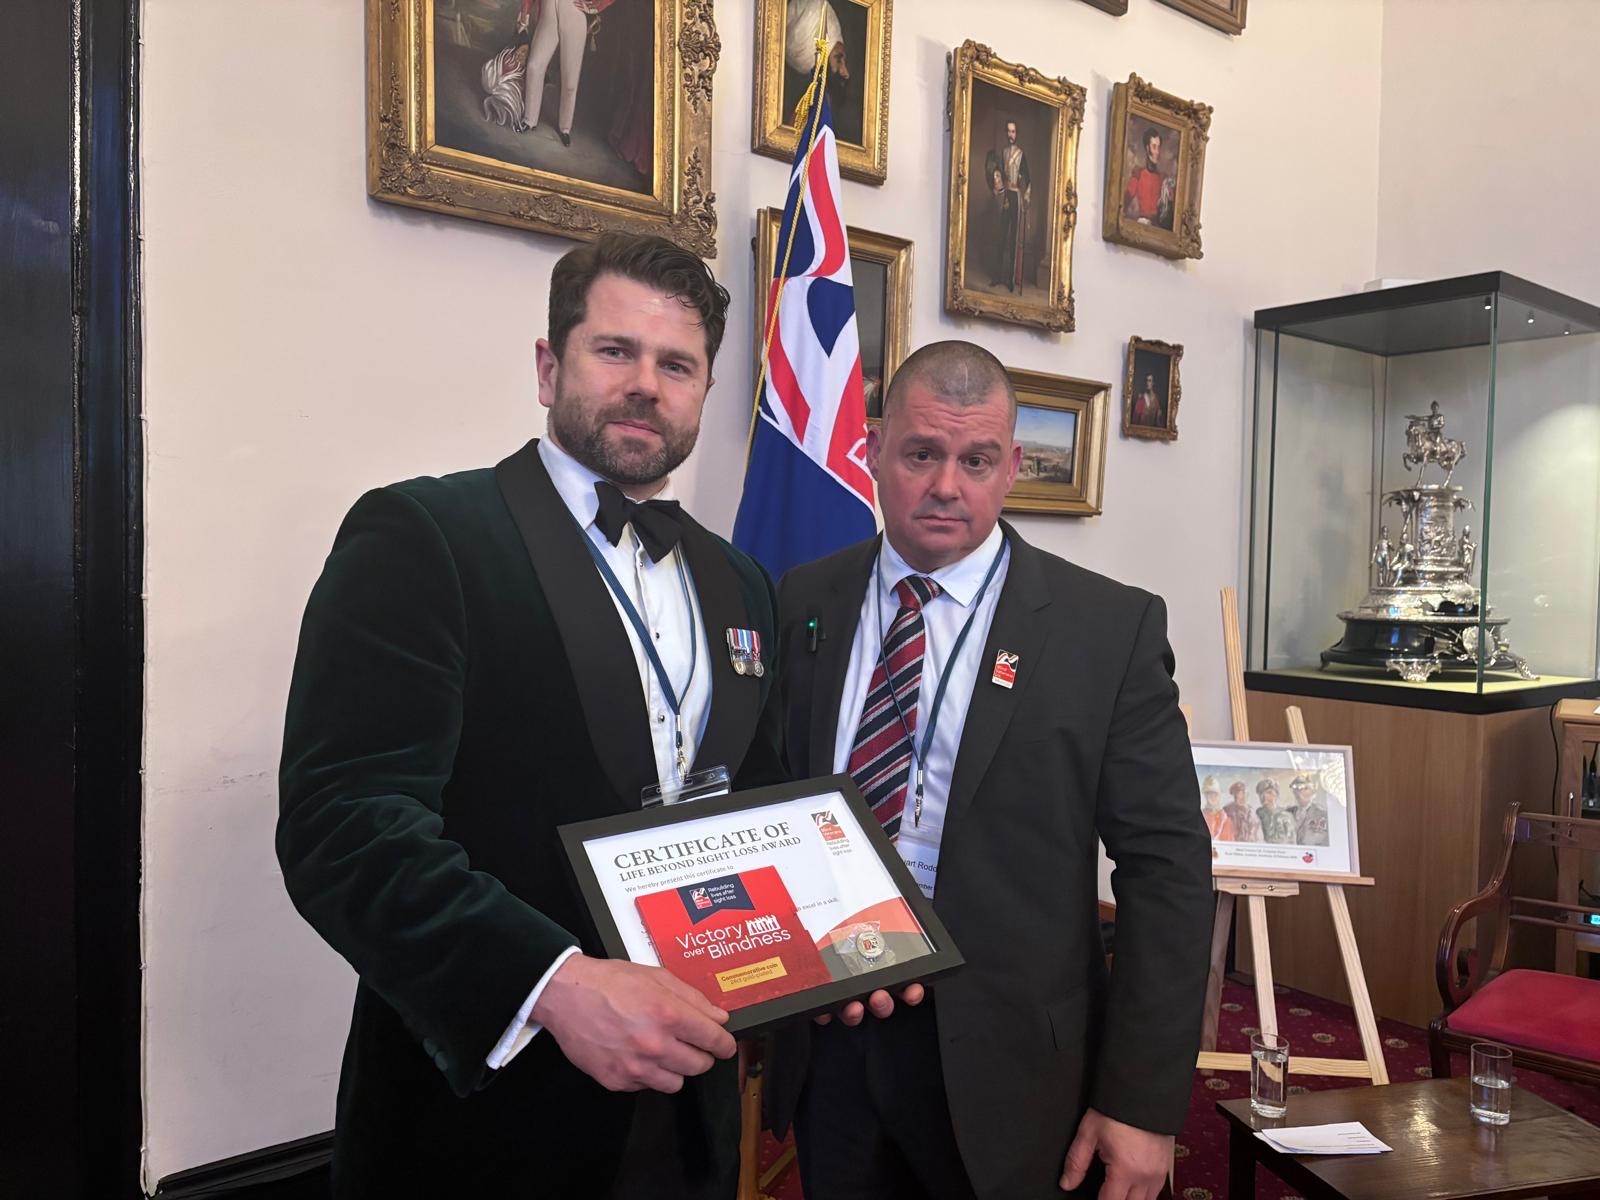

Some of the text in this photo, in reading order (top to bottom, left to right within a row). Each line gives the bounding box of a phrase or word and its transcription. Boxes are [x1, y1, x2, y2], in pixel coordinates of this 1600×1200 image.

[614, 821, 790, 869] CERTIFICATE OF
[619, 836, 801, 882] LIFE BEYOND SIGHT LOSS AWARD
[624, 886, 637, 894] We
[637, 881, 659, 891] hereby
[660, 876, 684, 887] present
[684, 872, 696, 881] this
[696, 866, 726, 879] certificate
[708, 883, 735, 893] Rebuilding
[675, 922, 742, 950] Victory
[683, 929, 791, 960] over Blindness
[721, 967, 766, 982] Commemorative
